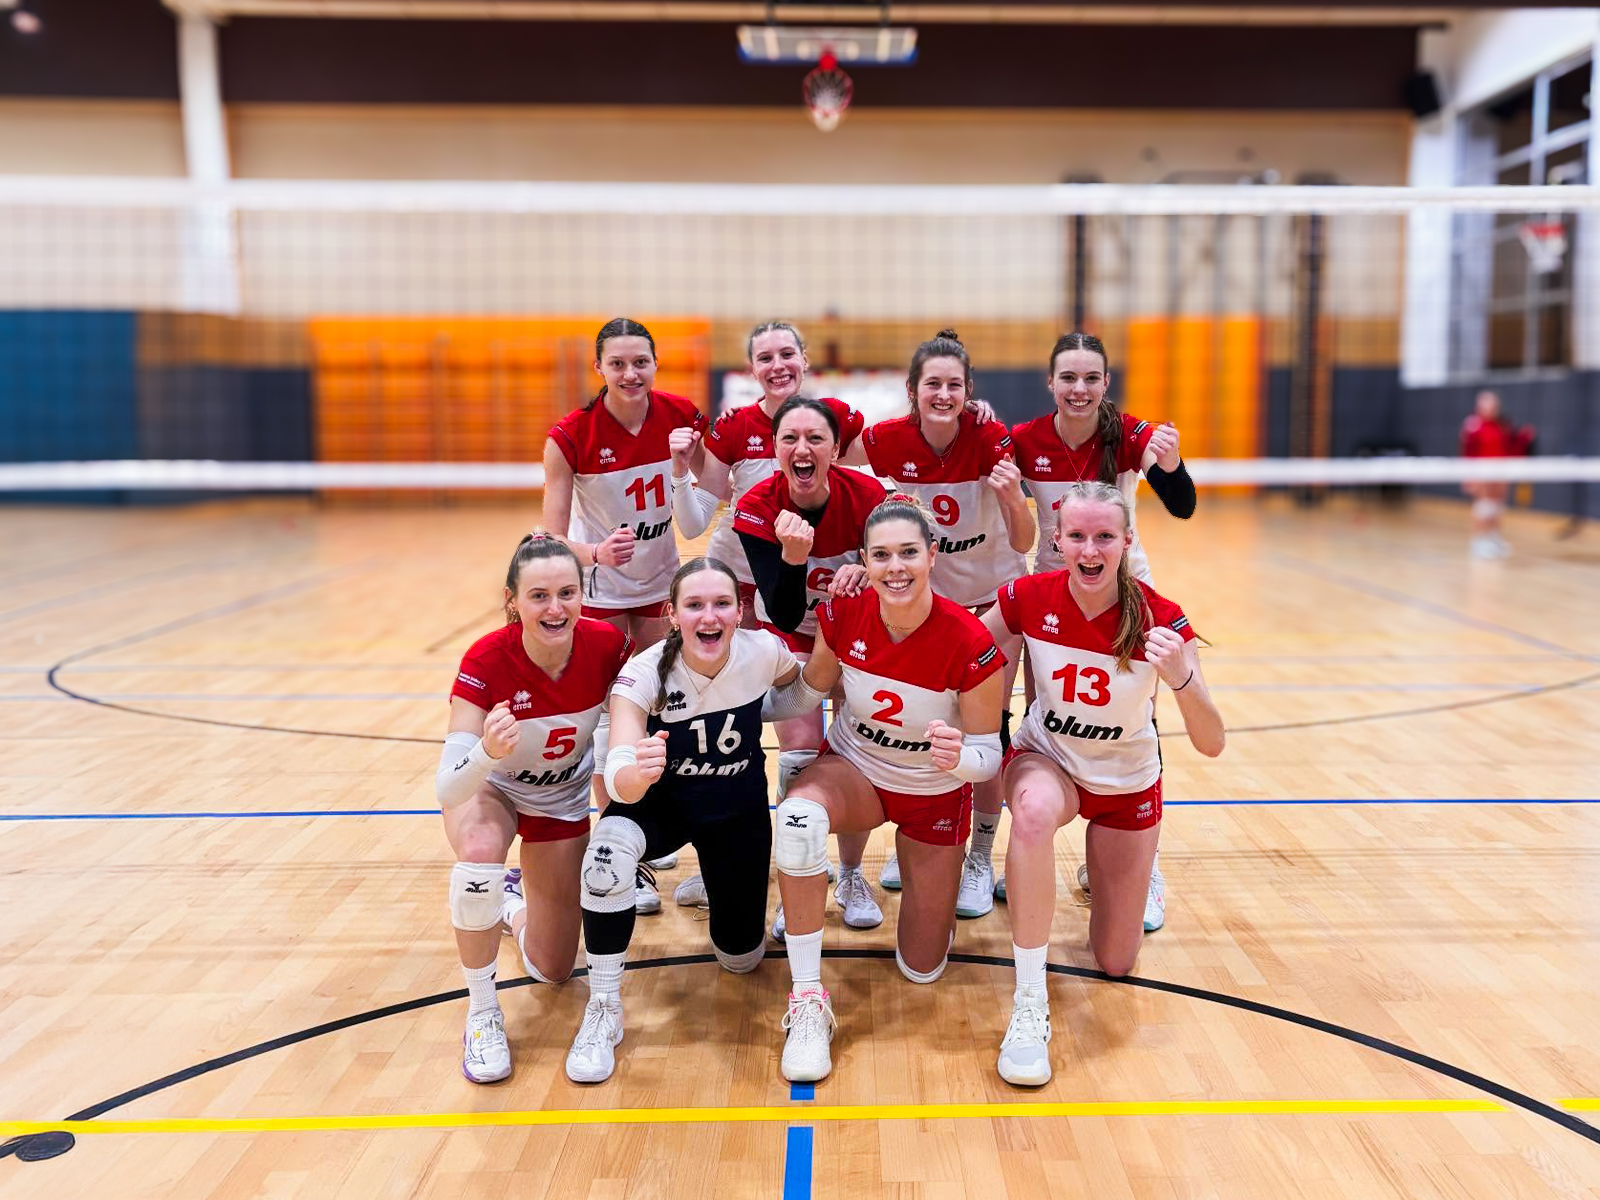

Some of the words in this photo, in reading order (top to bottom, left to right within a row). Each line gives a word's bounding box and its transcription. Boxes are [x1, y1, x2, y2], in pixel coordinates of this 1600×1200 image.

[625, 474, 665, 511] 11
[932, 494, 960, 526] 9
[619, 515, 672, 540] lum
[930, 533, 985, 553] lum
[806, 567, 834, 592] 6
[1052, 663, 1111, 706] 13
[870, 690, 904, 727] 2
[689, 713, 742, 754] 16
[856, 722, 932, 752] blum
[1043, 709, 1123, 740] blum
[542, 727, 577, 760] 5
[675, 757, 749, 776] blum
